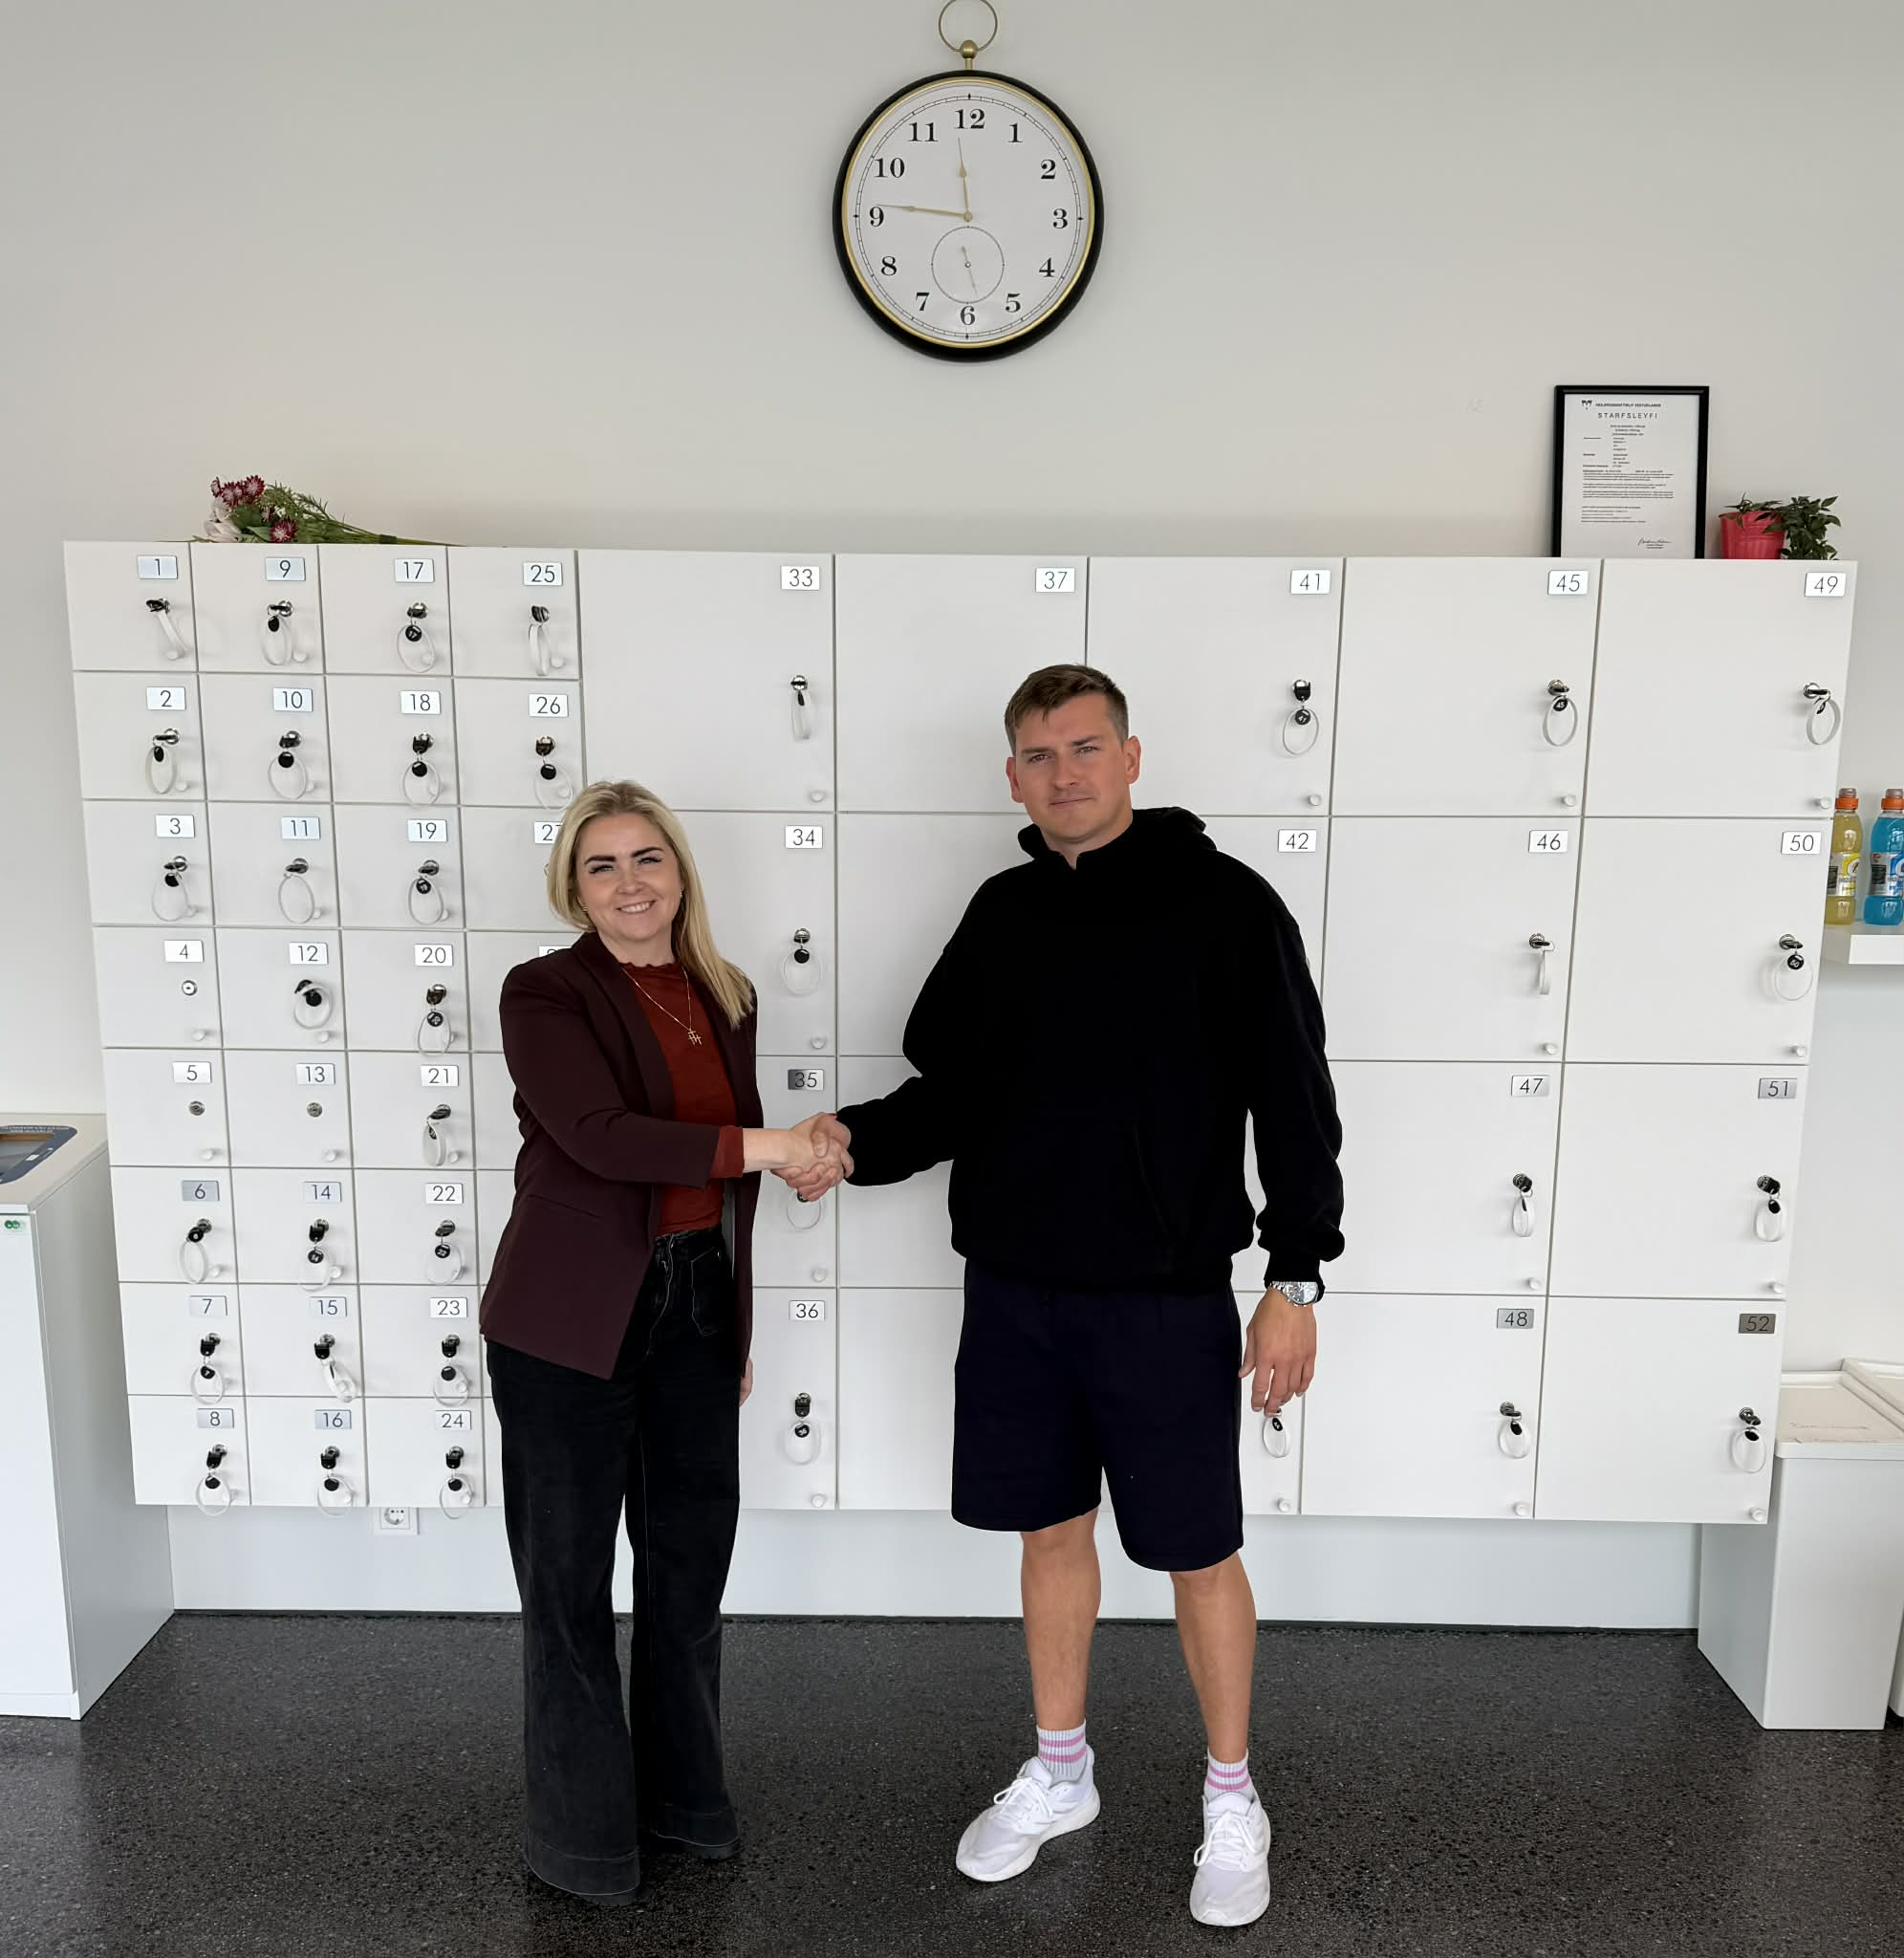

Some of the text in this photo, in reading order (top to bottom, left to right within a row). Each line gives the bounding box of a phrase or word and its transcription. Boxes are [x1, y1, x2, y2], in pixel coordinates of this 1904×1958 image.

[955, 108, 985, 130] 12
[909, 121, 939, 142] 11
[1008, 122, 1023, 143] 1
[874, 157, 905, 179] 10
[1040, 159, 1056, 180] 2
[869, 206, 884, 228] 9
[1052, 208, 1069, 229] 3
[880, 256, 898, 276] 8
[1038, 257, 1055, 278] 4
[915, 292, 930, 312] 7
[1005, 293, 1021, 313] 5
[960, 305, 976, 326] 6
[154, 557, 161, 577] 1
[279, 559, 292, 578] 9
[403, 561, 424, 579] 17
[530, 564, 555, 583] 25
[789, 568, 813, 587] 33
[1044, 571, 1068, 590] 37
[1299, 573, 1321, 592] 41
[1556, 574, 1581, 593] 45
[1813, 576, 1839, 594] 49
[160, 689, 173, 707] 2
[282, 690, 303, 709] 10
[410, 693, 431, 711] 18
[536, 696, 561, 715] 26
[169, 817, 182, 836] 3
[291, 819, 308, 837] 11
[416, 821, 437, 839] 19
[791, 828, 815, 847] 34
[1286, 832, 1309, 850] 42
[1536, 833, 1561, 851] 46
[1789, 834, 1814, 852] 50
[179, 944, 189, 960] 4
[297, 945, 318, 962] 12
[422, 946, 446, 964] 20
[186, 1064, 198, 1081] 5
[305, 1065, 326, 1083] 13
[428, 1067, 449, 1084] 21
[794, 1071, 817, 1088] 35
[1519, 1077, 1544, 1094] 47
[1767, 1080, 1788, 1098] 51
[194, 1183, 206, 1200] 6
[313, 1184, 332, 1200] 14
[432, 1185, 456, 1202] 22
[202, 1297, 213, 1315] 7
[317, 1299, 338, 1316] 15
[437, 1299, 461, 1316] 23
[795, 1303, 819, 1319] 36
[1504, 1311, 1527, 1327] 48
[1745, 1316, 1770, 1332] 52
[209, 1410, 221, 1426] 8
[323, 1412, 343, 1428] 16
[441, 1412, 464, 1428] 24
